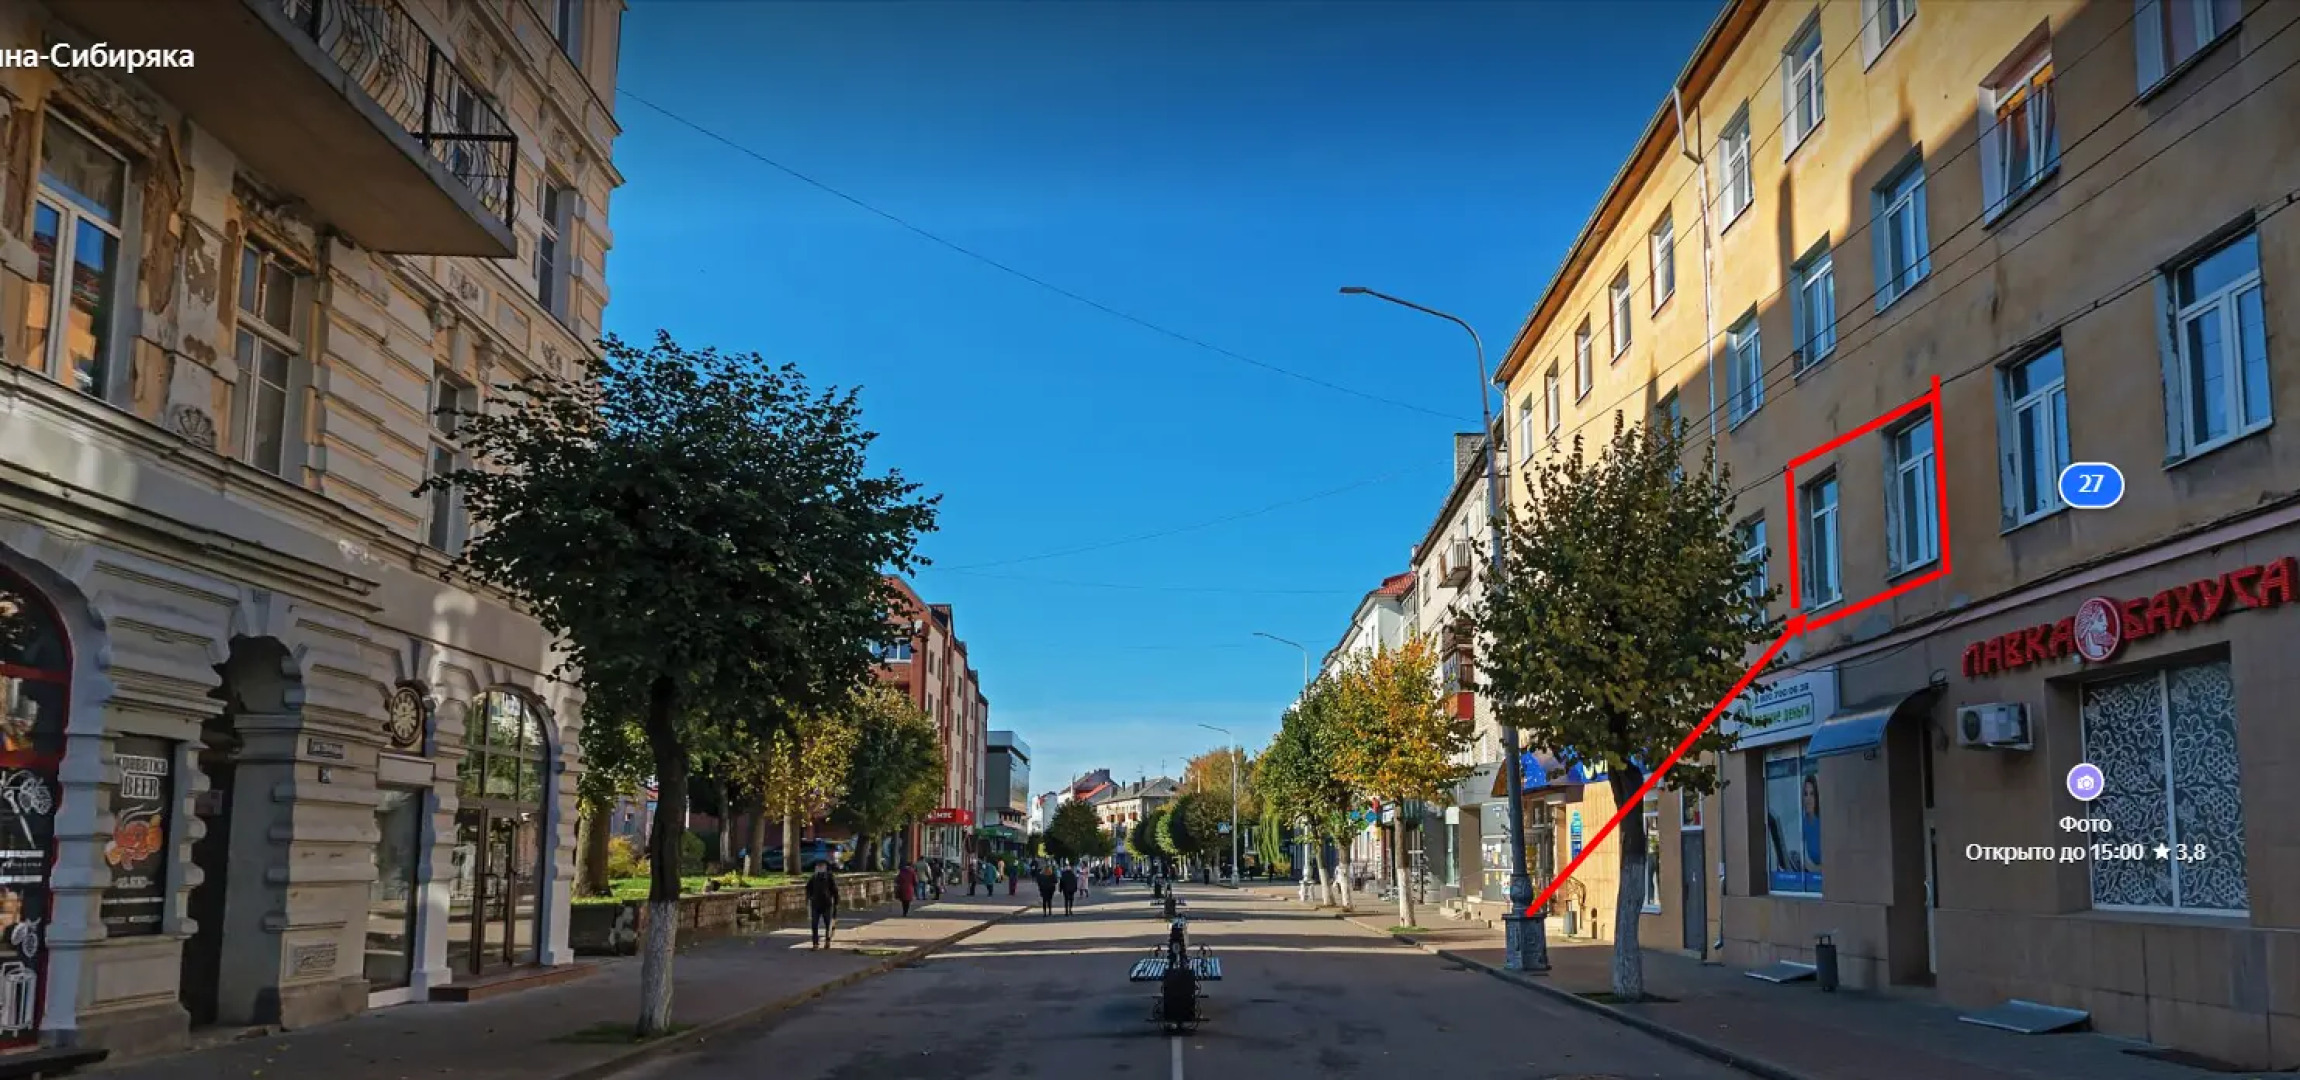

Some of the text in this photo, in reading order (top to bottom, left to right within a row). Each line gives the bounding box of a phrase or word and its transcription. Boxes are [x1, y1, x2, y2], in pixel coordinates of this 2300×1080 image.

[1961, 556, 2299, 678] ЛАВКА БАХУСА
[121, 775, 159, 799] BEER
